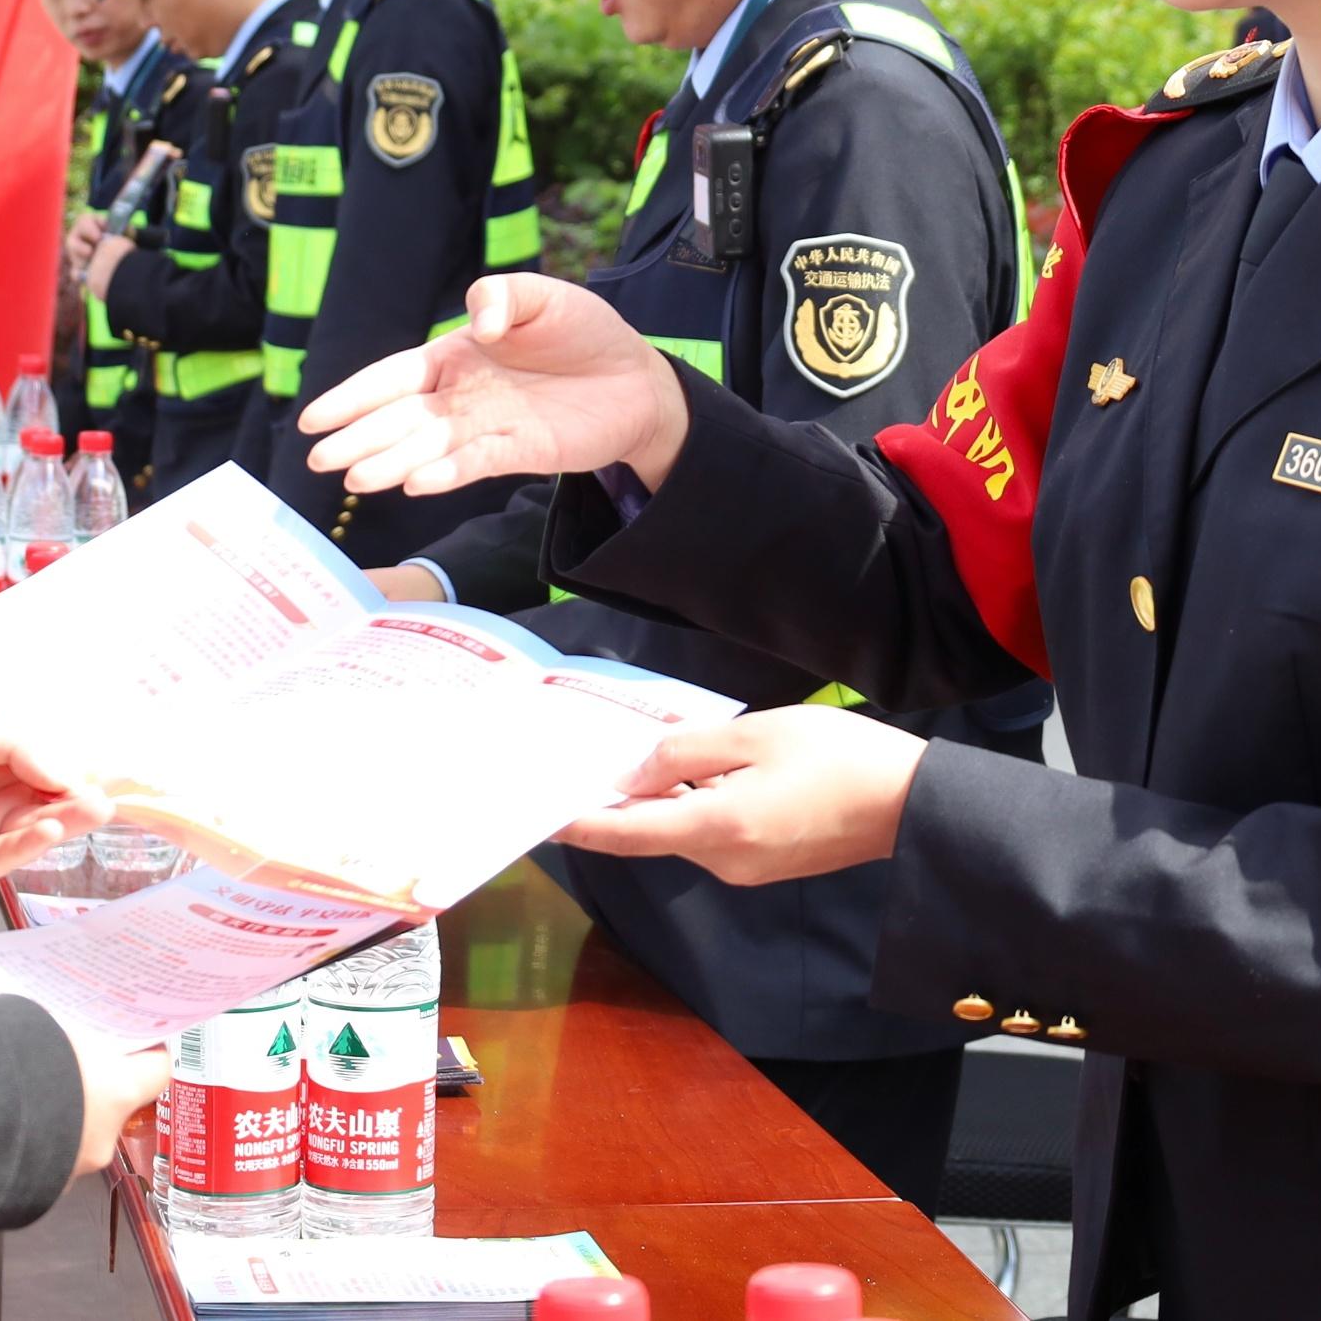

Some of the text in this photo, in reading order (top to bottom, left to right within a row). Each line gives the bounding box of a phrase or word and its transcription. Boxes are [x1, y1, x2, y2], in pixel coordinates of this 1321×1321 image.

[794, 246, 902, 276] 中华人民共和国
[804, 270, 891, 291] 交通运输执法
[234, 1102, 300, 1139] 农夫山
[309, 1102, 400, 1139] 农夫山泉
[234, 1137, 285, 1158] NONGFU
[349, 1140, 400, 1156] SPRING
